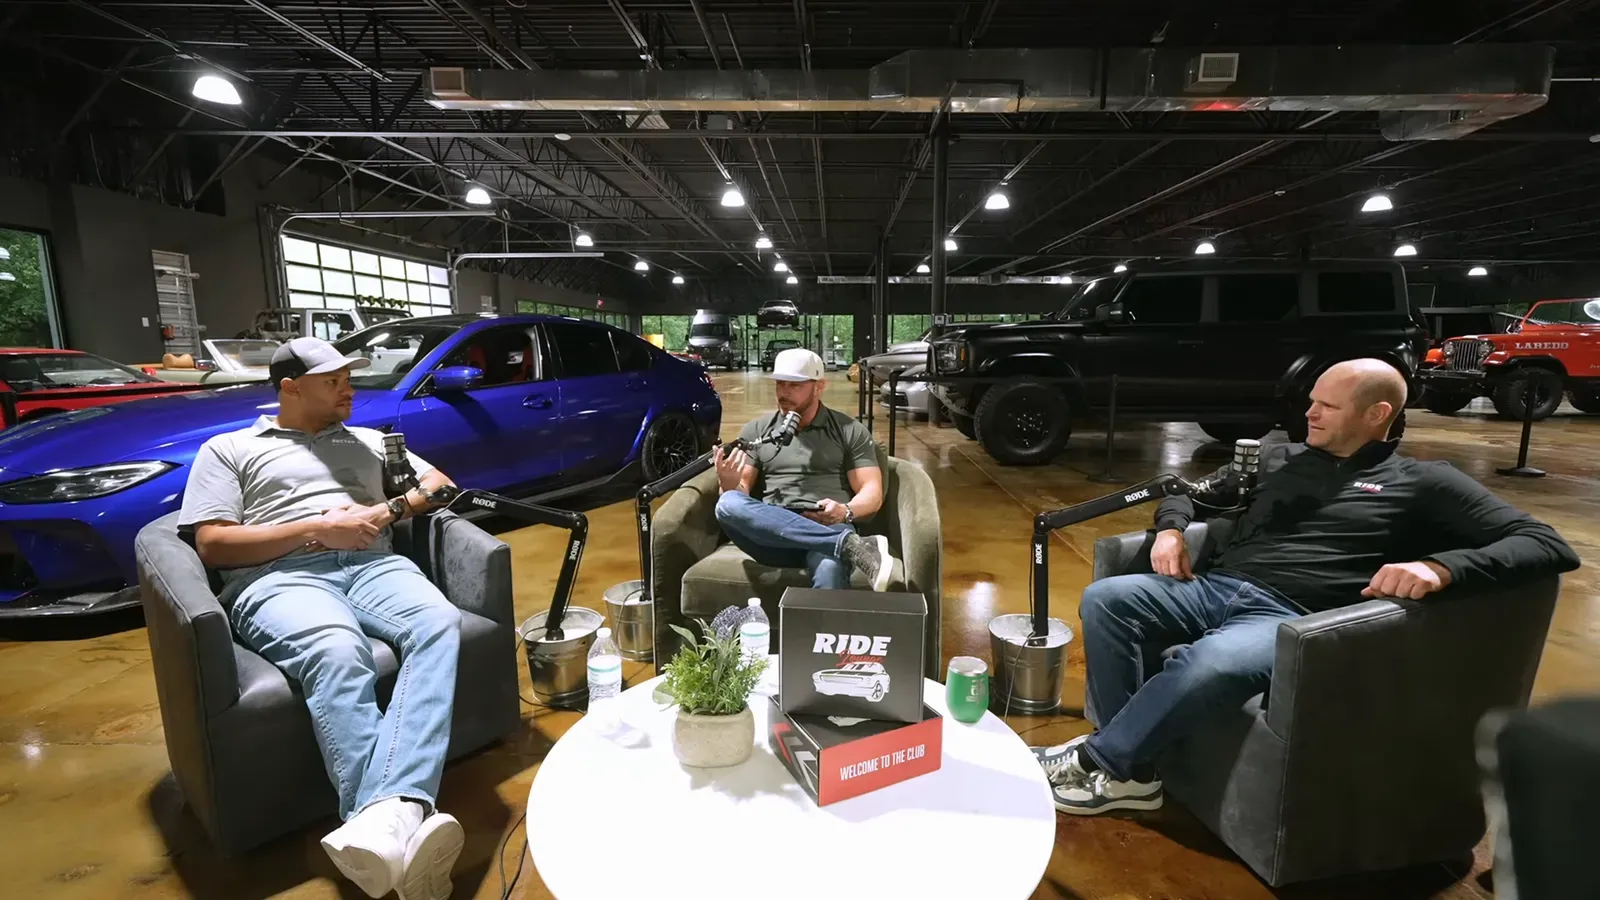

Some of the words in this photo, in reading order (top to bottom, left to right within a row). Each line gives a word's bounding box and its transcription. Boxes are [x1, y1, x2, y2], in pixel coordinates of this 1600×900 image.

[1515, 342, 1569, 350] LAREDO
[1353, 481, 1384, 492] RIDE
[1124, 488, 1150, 504] RØDE
[812, 632, 892, 657] RIDE
[839, 757, 880, 781] WELCOME
[880, 753, 891, 769] TO
[891, 749, 906, 766] THE
[906, 744, 926, 761] CLUB
